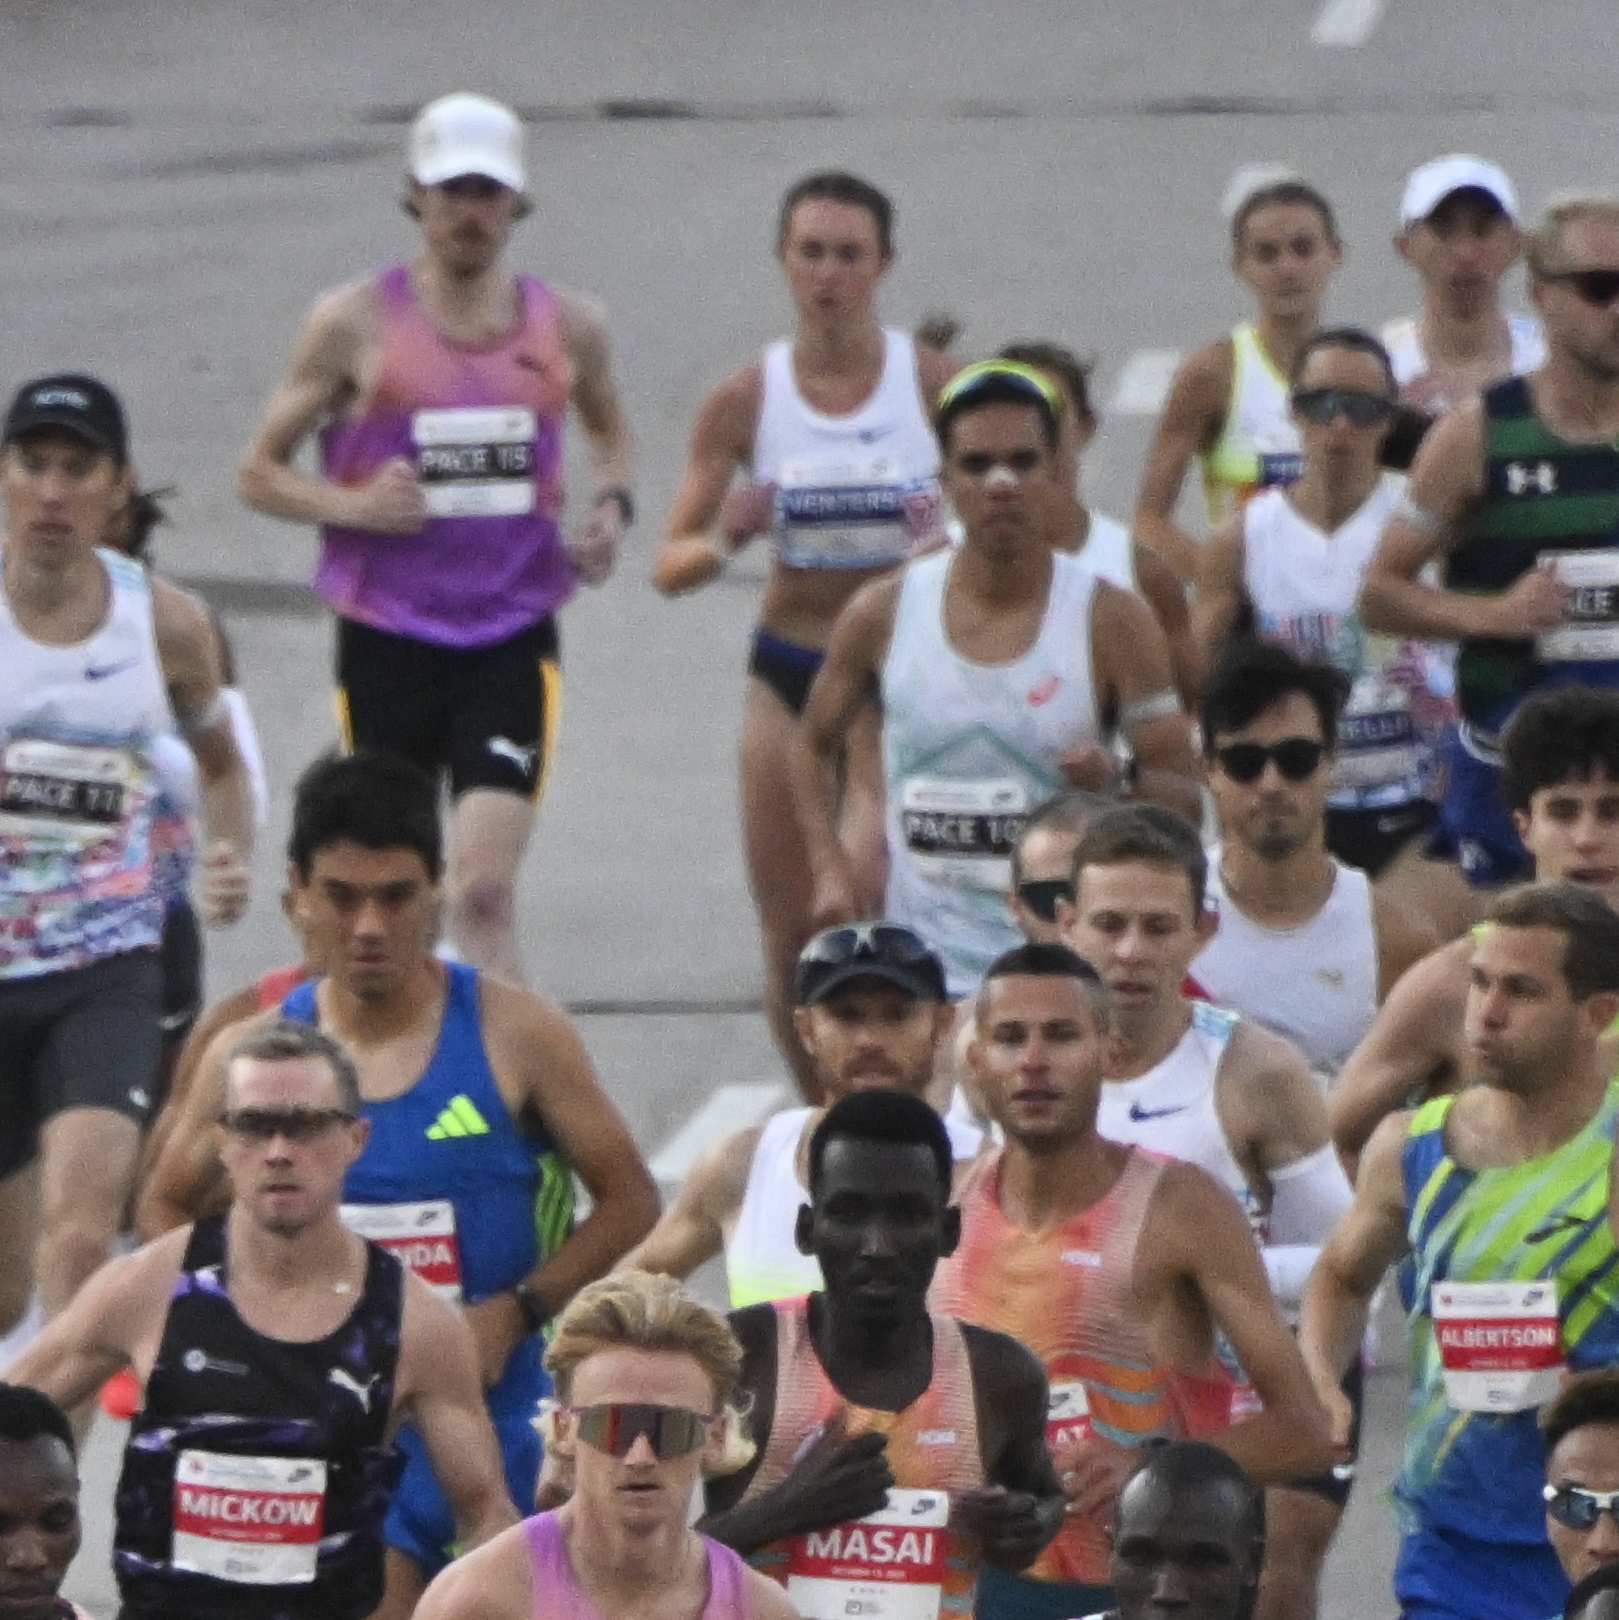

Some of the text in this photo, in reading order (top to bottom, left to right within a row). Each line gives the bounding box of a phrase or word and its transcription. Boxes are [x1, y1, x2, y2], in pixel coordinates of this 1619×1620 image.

[906, 814, 978, 846] PACE
[1440, 1327, 1555, 1350] ALBERTSON
[180, 1489, 321, 1525] MICKOW
[804, 1529, 934, 1566] MASAI
